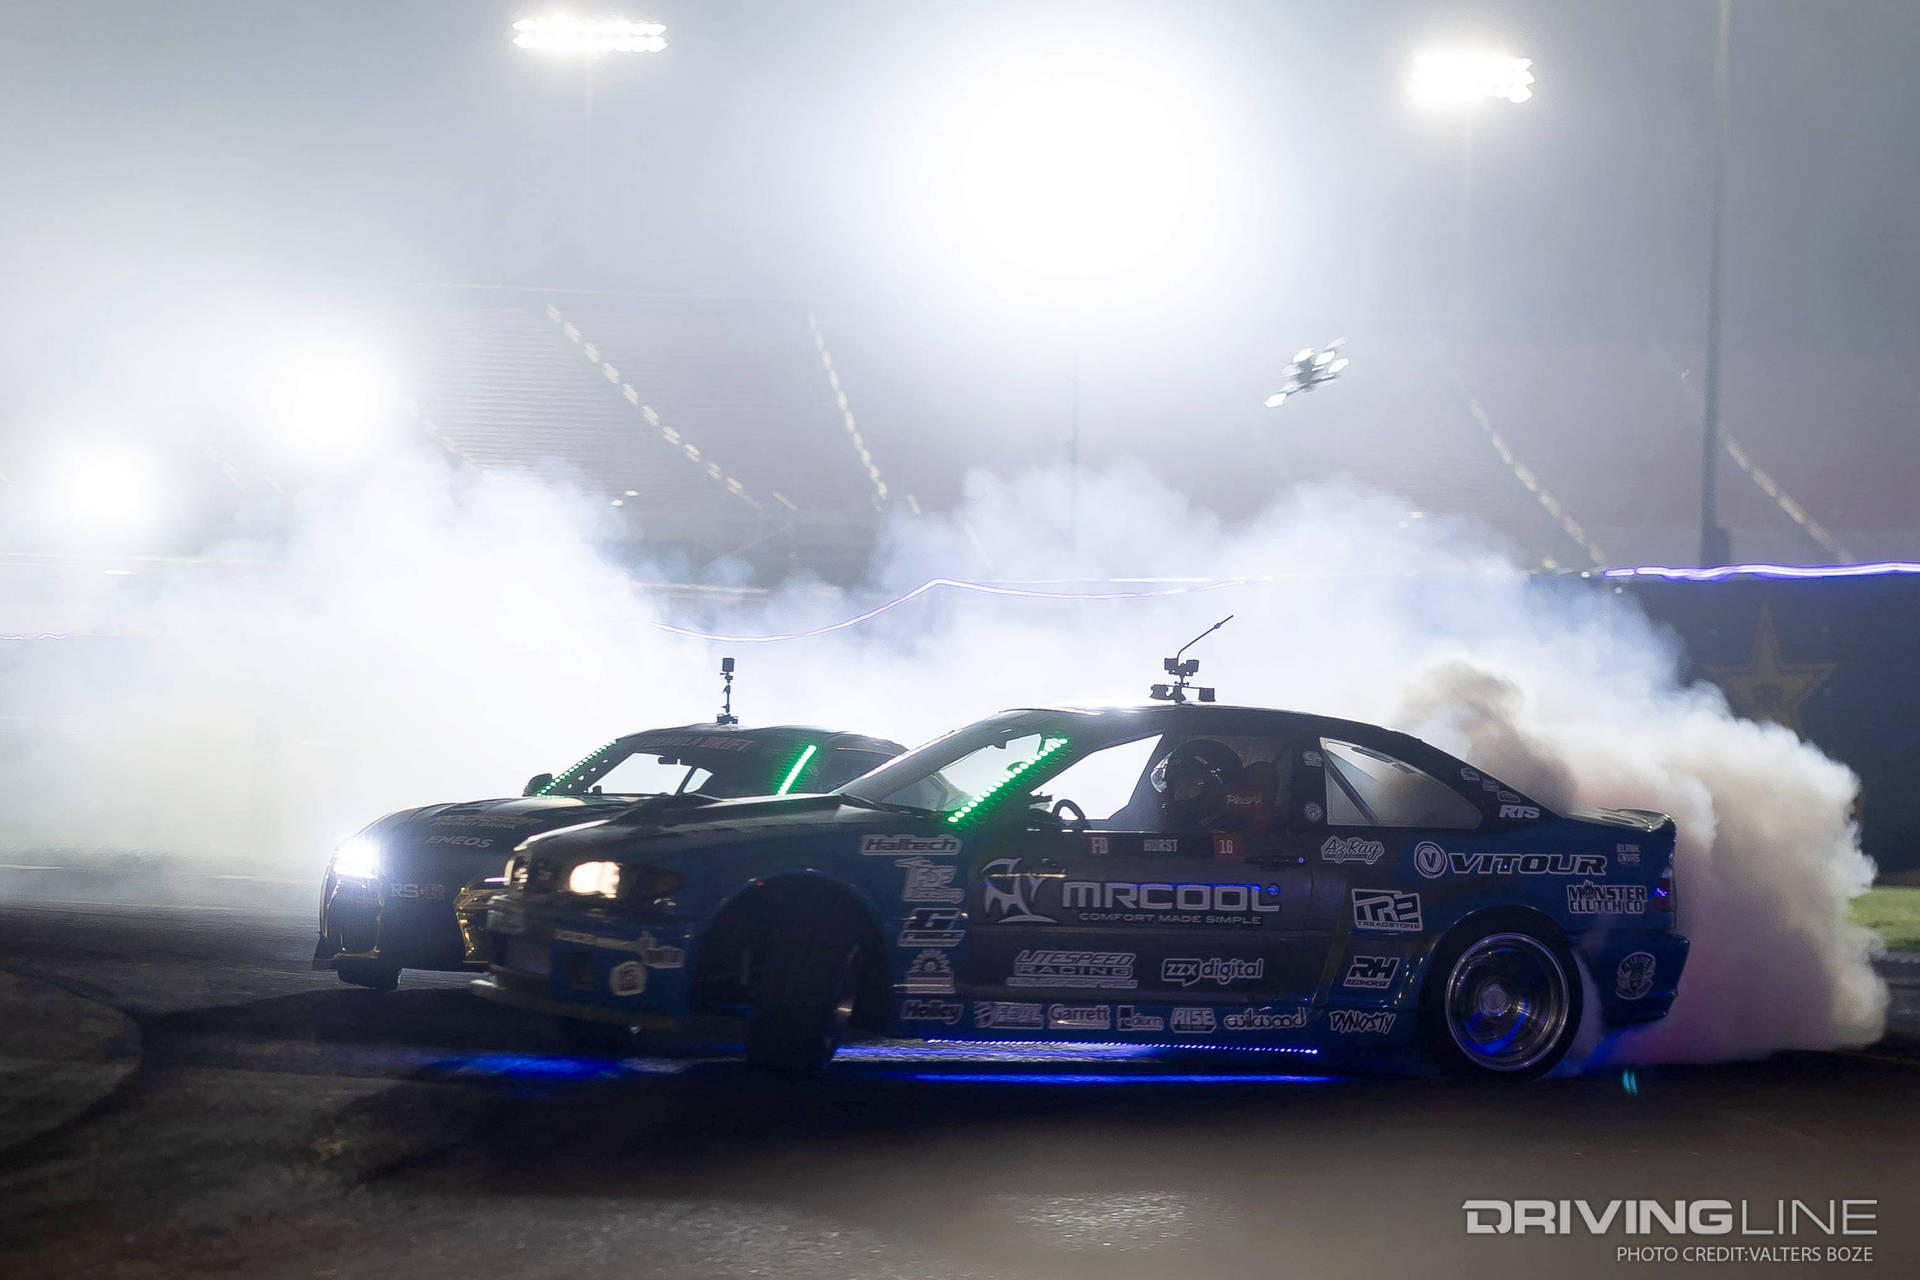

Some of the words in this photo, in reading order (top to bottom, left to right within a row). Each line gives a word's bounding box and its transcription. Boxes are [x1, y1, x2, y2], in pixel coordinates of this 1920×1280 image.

[1498, 805, 1541, 819] RTS
[426, 834, 493, 849] ENEOS
[863, 836, 960, 853] Haltech
[1143, 839, 1179, 853] HURST
[1217, 839, 1234, 855] 16
[1448, 853, 1607, 875] VITOUR
[1061, 881, 1279, 913] MRCOOL
[1567, 885, 1647, 901] MONSTER
[1569, 900, 1623, 913] CLUTCH
[1625, 900, 1644, 913] CO
[1079, 912, 1155, 923] COMFORT
[1158, 913, 1202, 923] MADE
[1205, 914, 1262, 925] SIMPLE
[1357, 920, 1421, 931] TREADSTONE
[1016, 950, 1136, 966] LITESPEED
[1017, 965, 1133, 978] RACING
[902, 1000, 963, 1024] Holley
[1049, 1003, 1110, 1022] Garrett
[1172, 1007, 1213, 1026] RISE
